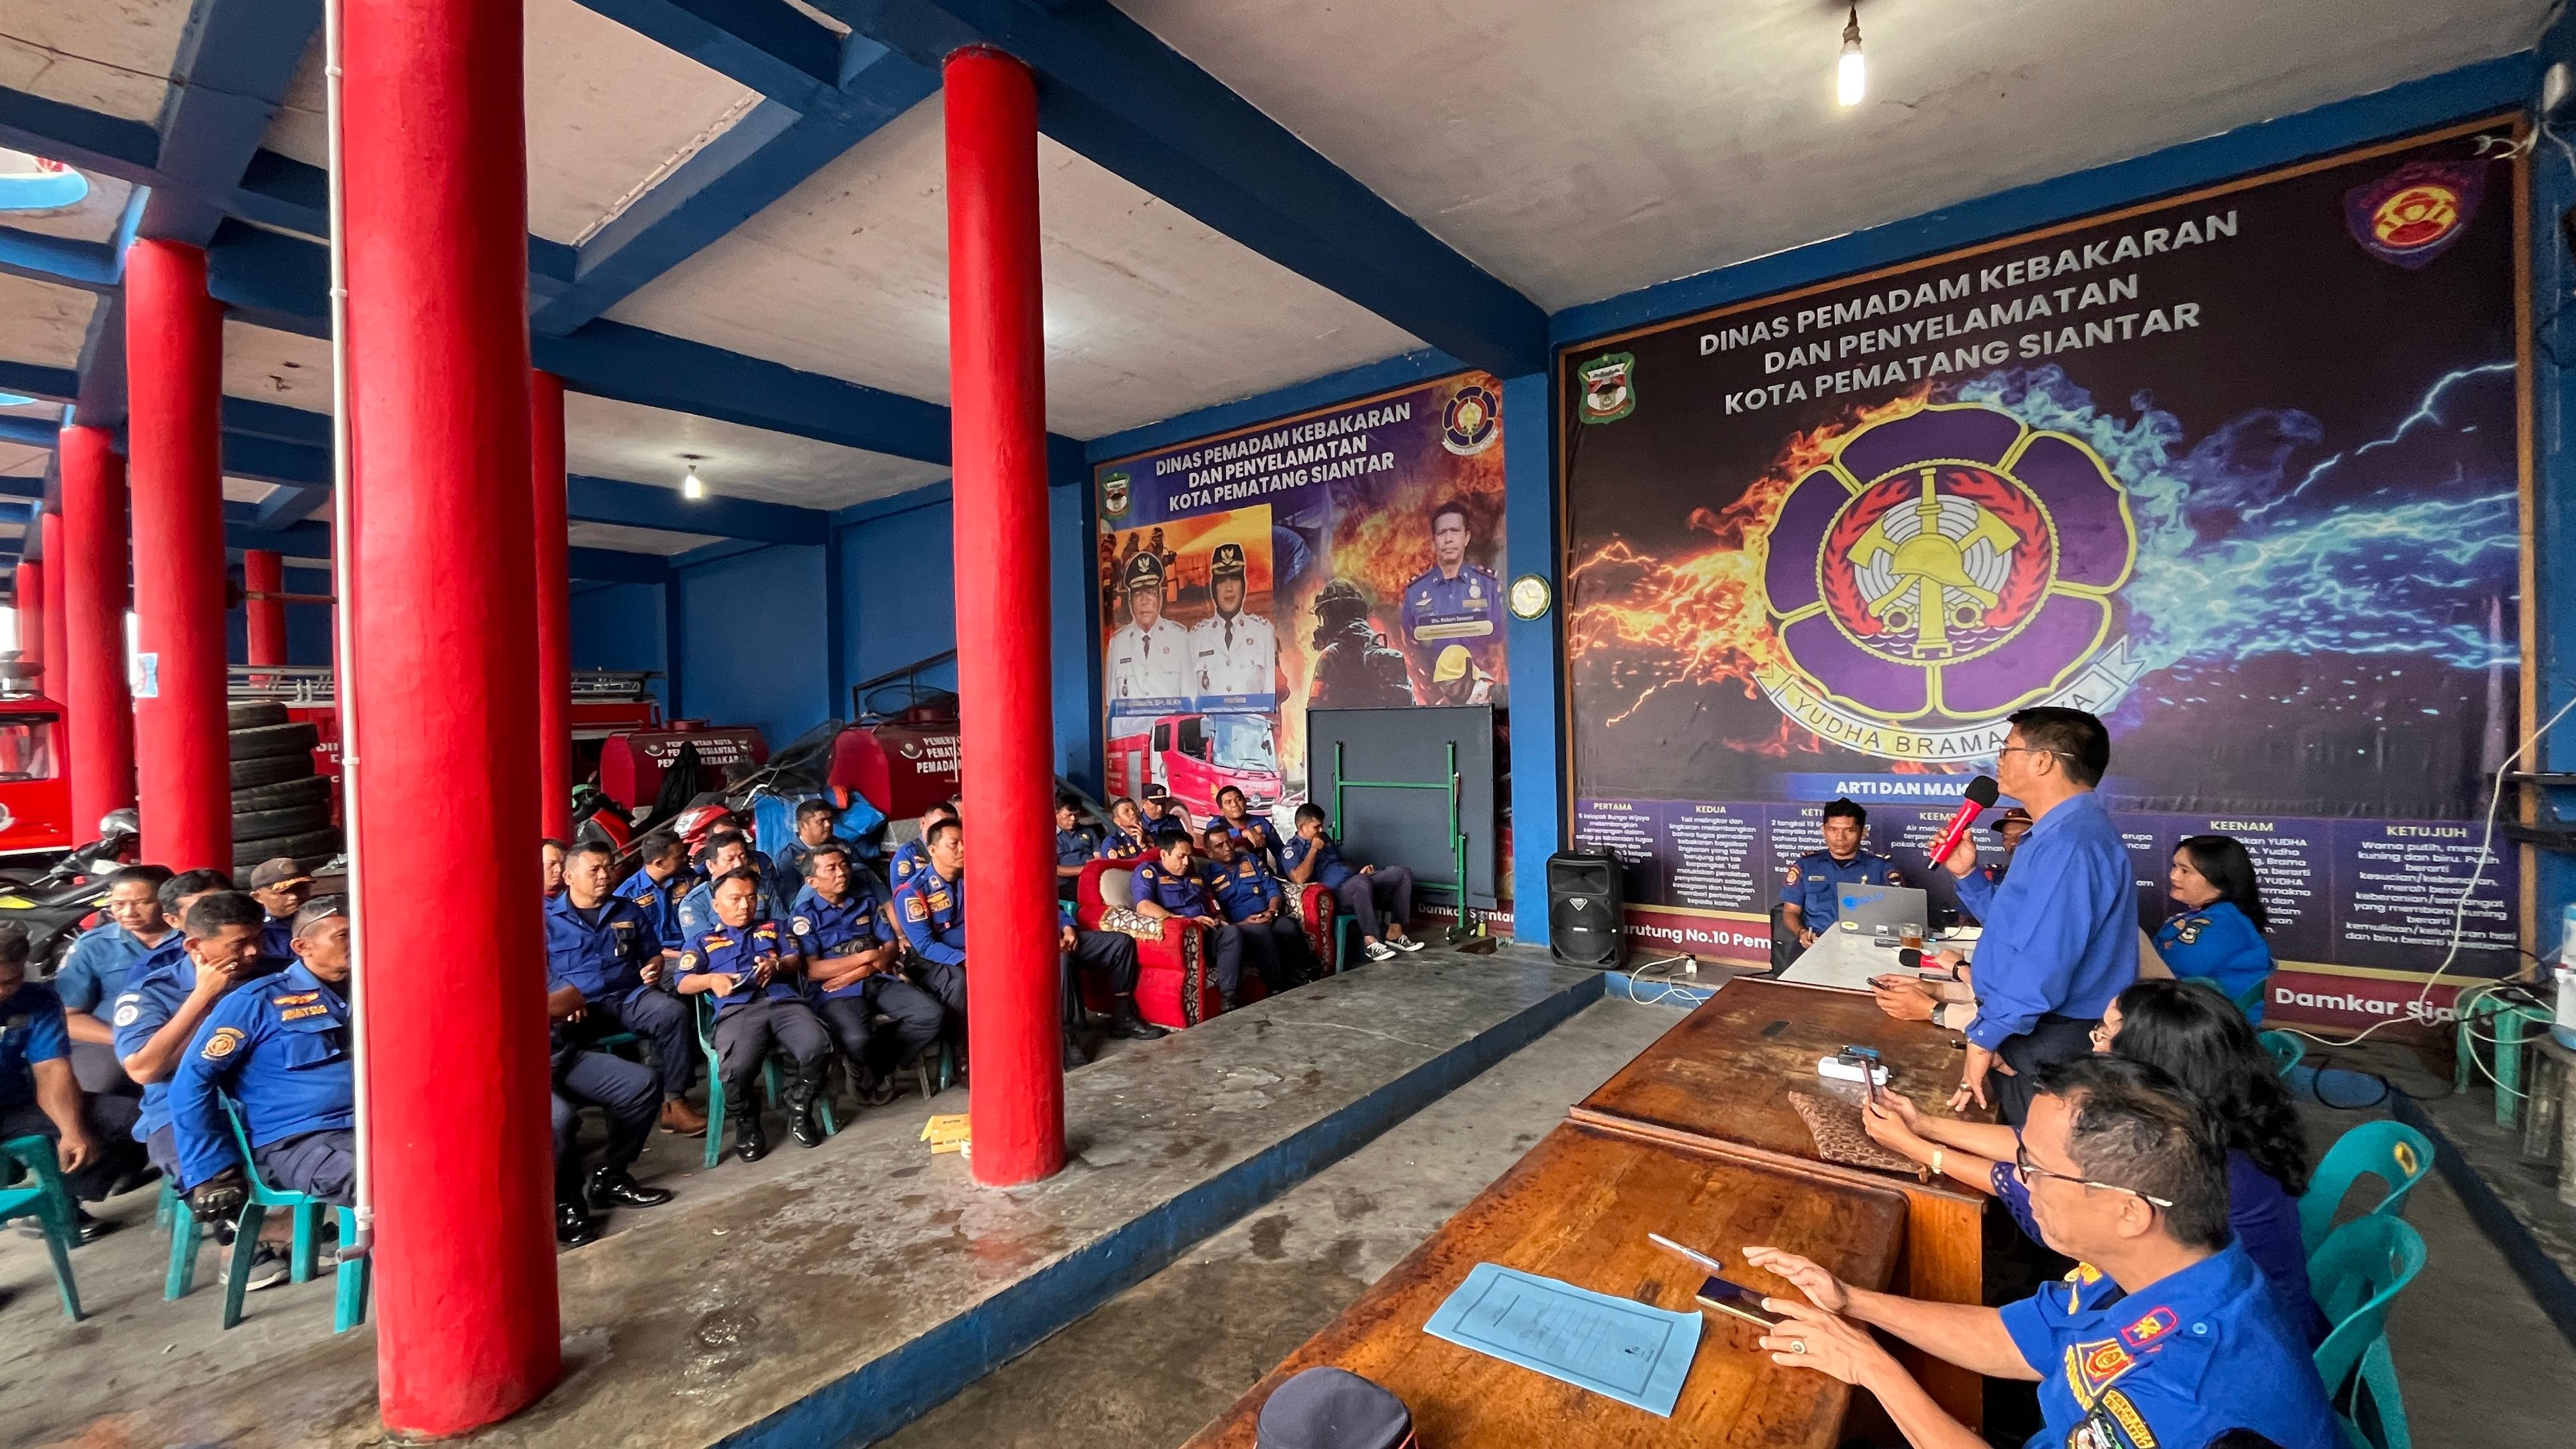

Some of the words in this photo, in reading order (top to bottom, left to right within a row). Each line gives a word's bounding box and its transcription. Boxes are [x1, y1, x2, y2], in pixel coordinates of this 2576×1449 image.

[1700, 316, 1790, 356] DINAS
[1798, 273, 1971, 334] PEMADAM
[1981, 210, 2238, 293] KEBAKARAN
[1765, 340, 1831, 374] DAN
[1840, 273, 2138, 358] PENYELAMATAN
[1725, 381, 1807, 415] KOTA
[1815, 341, 2010, 398] PEMATANG
[2019, 302, 2200, 358] SIANTAR
[1156, 451, 1202, 476] DINAS
[1204, 430, 1289, 465] PEMADAM
[1292, 402, 1411, 445] KEBAKARAN
[1188, 466, 1222, 488] DAN
[1225, 434, 1367, 480] PENYELAMATAN
[1169, 489, 1211, 511] KOTA
[1214, 469, 1308, 503] PEMATANG
[1311, 452, 1395, 483] SIANTAR
[1795, 697, 1880, 749] YUDHA
[1896, 730, 2005, 755] BRAMA
[1836, 781, 1876, 794] ARTI
[1880, 781, 1920, 795] DAN
[1924, 783, 1968, 796] MAK
[1593, 802, 1632, 811] PERTAMA
[1696, 805, 1727, 814] KEDUA
[1919, 812, 1958, 821] KEEMP
[2210, 820, 2274, 832] KEENAM
[2386, 825, 2468, 838] KETUJUH
[1686, 928, 1729, 945] No.10
[2275, 988, 2399, 1016] Damkar
